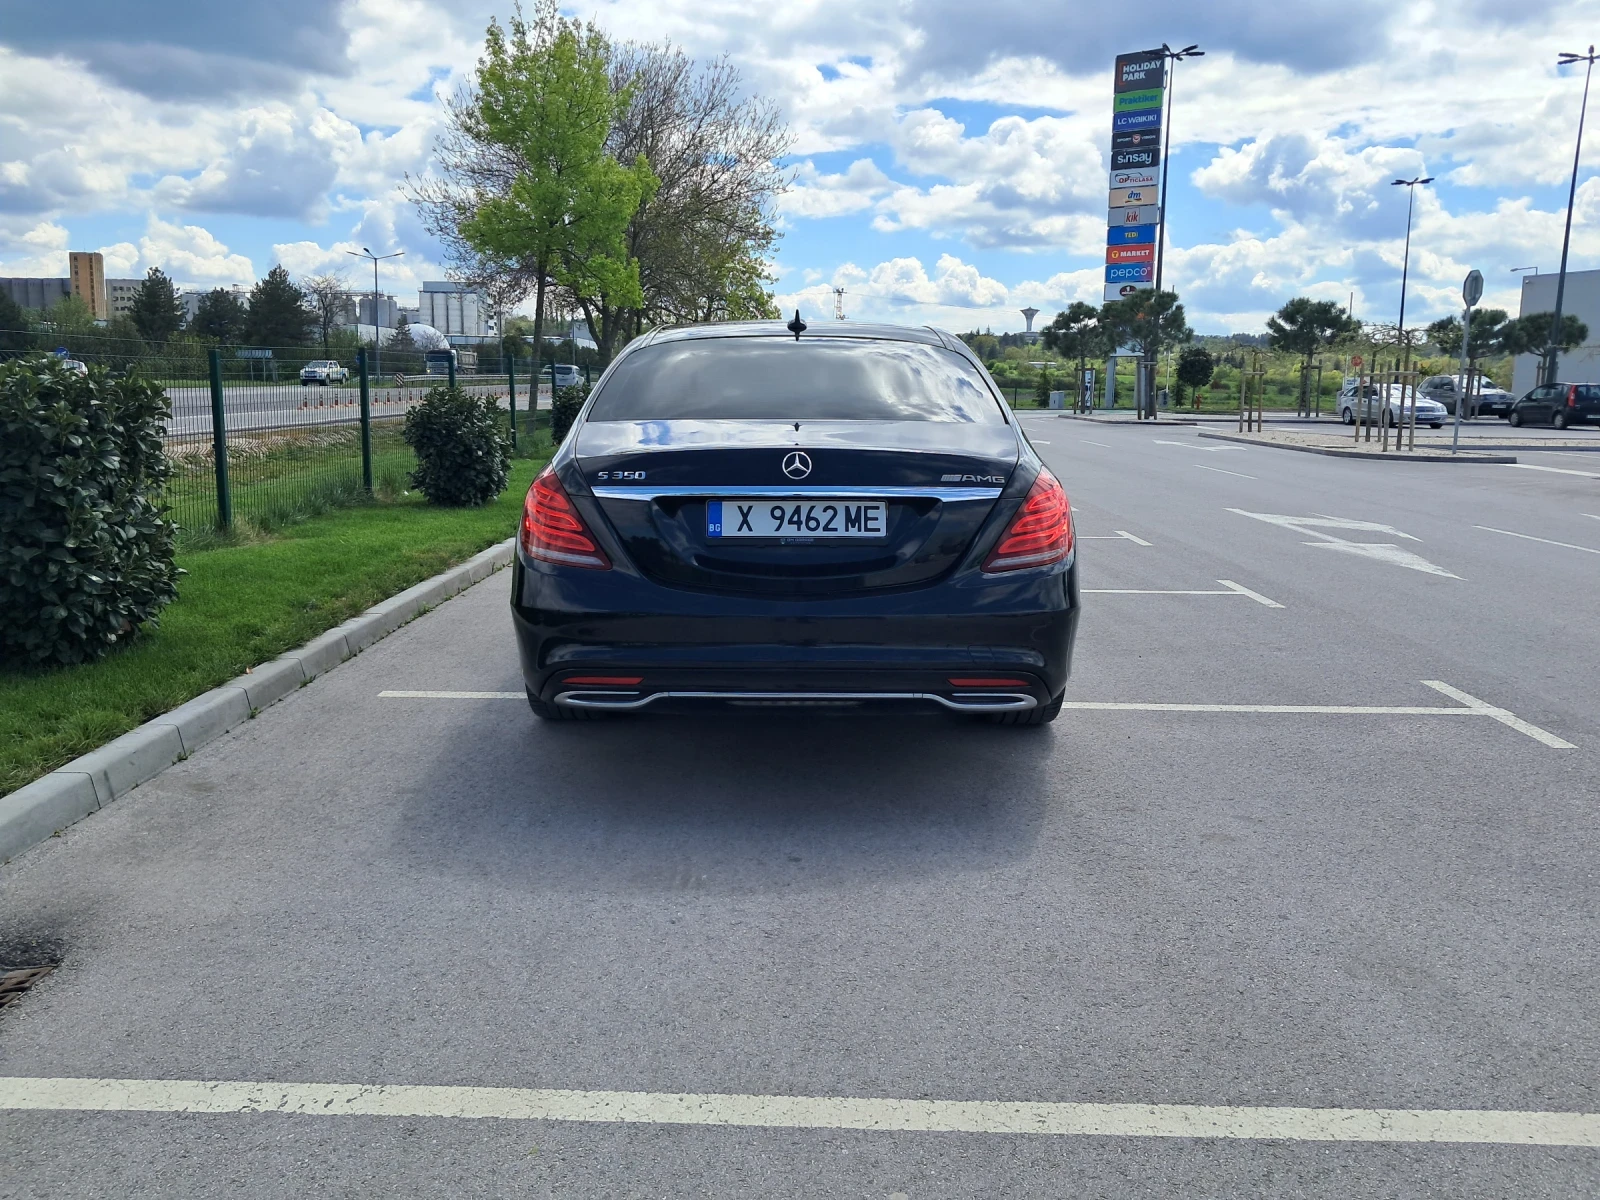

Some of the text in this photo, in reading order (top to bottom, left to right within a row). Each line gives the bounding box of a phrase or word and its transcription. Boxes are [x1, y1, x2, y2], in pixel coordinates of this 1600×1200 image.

[1122, 60, 1162, 73] HOLIDAY
[1122, 71, 1146, 82] PARK
[1119, 94, 1158, 106] Praktiker
[1117, 117, 1128, 125] LC
[1117, 152, 1152, 164] sinsay
[1127, 190, 1141, 199] dm
[1110, 267, 1148, 279] pepco
[597, 471, 646, 480] S 350
[961, 474, 1005, 484] AMG
[736, 505, 881, 532] X 9462 ME
[708, 523, 721, 532] BG
